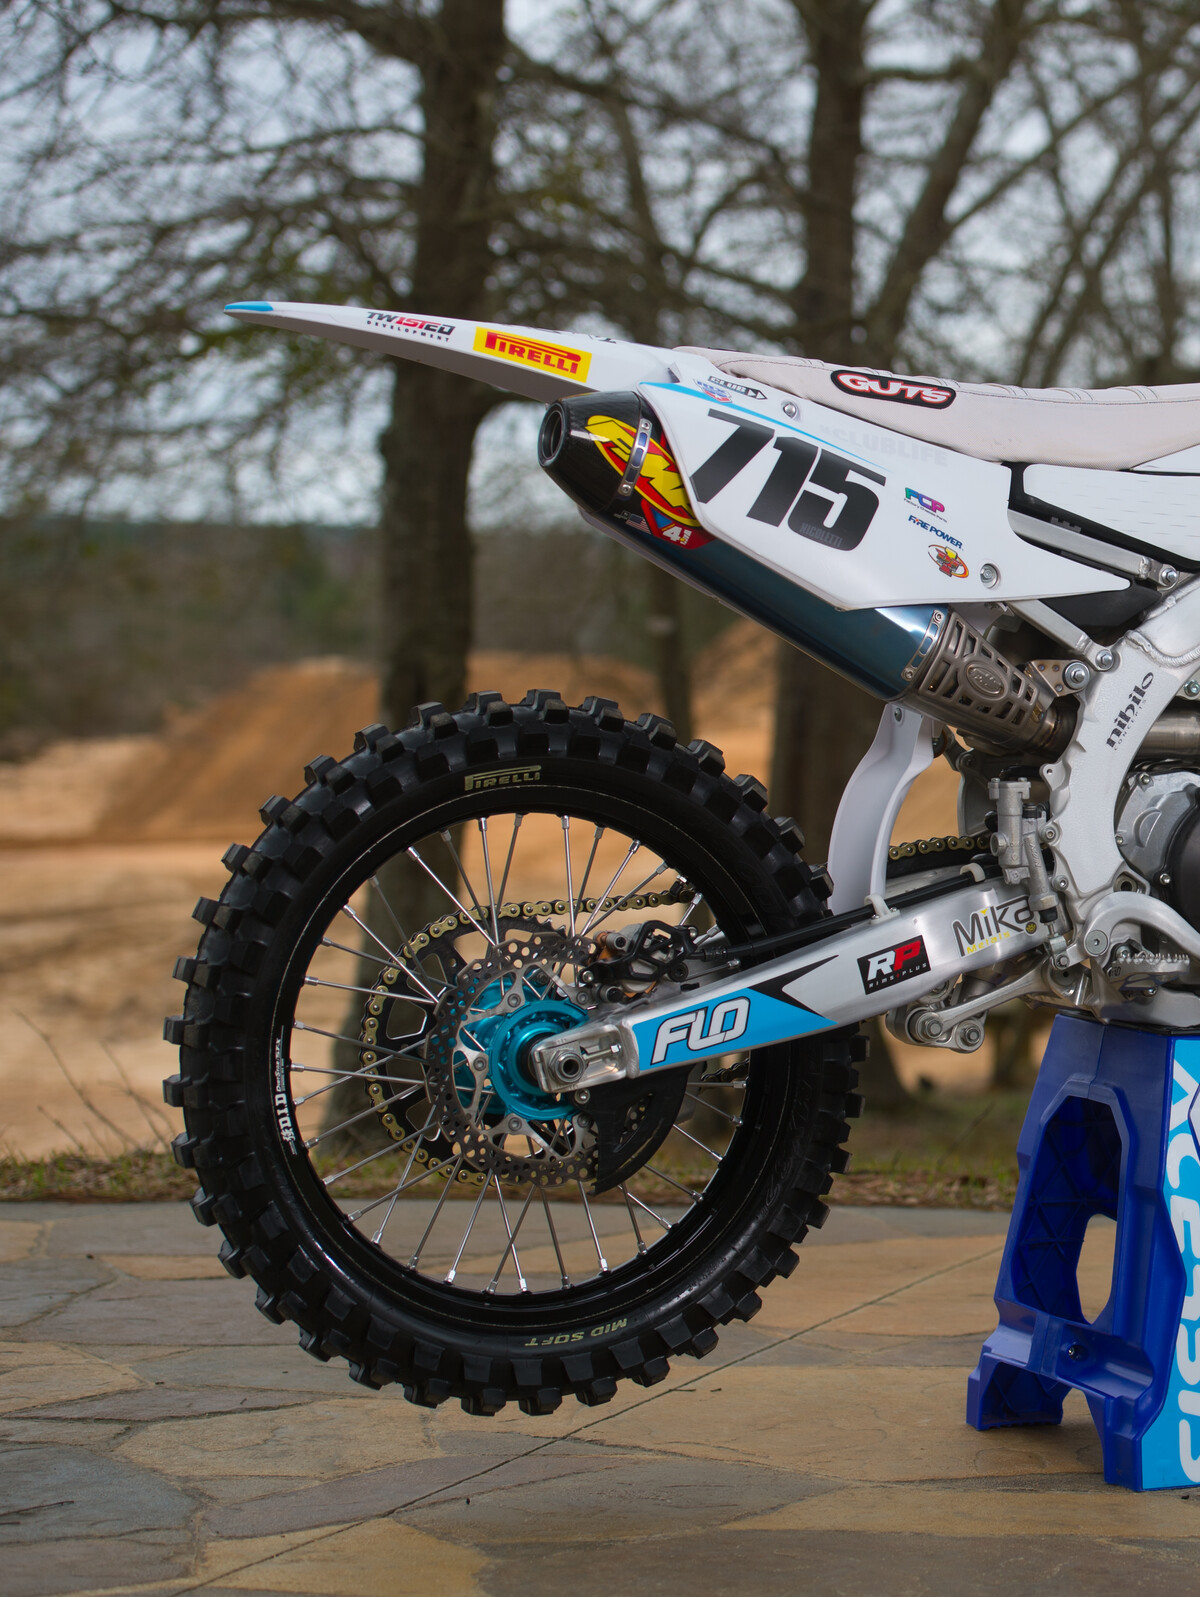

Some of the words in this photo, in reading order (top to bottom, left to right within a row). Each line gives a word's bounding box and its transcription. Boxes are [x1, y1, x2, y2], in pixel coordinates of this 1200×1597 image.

[366, 320, 450, 342] DEVELOPMENT
[367, 311, 456, 336] TWISTED
[485, 331, 581, 374] PIRELLI
[834, 372, 952, 404] GUTS
[690, 408, 887, 551] 715
[905, 487, 945, 513] FCP
[929, 525, 963, 549] POWER
[464, 765, 541, 791] PIRELLI
[952, 894, 1035, 957] Mika
[967, 930, 1010, 955] Metals
[867, 940, 921, 981] RP
[650, 996, 751, 1066] FLO
[524, 1331, 585, 1347] SOFT
[590, 1318, 628, 1337] MID
